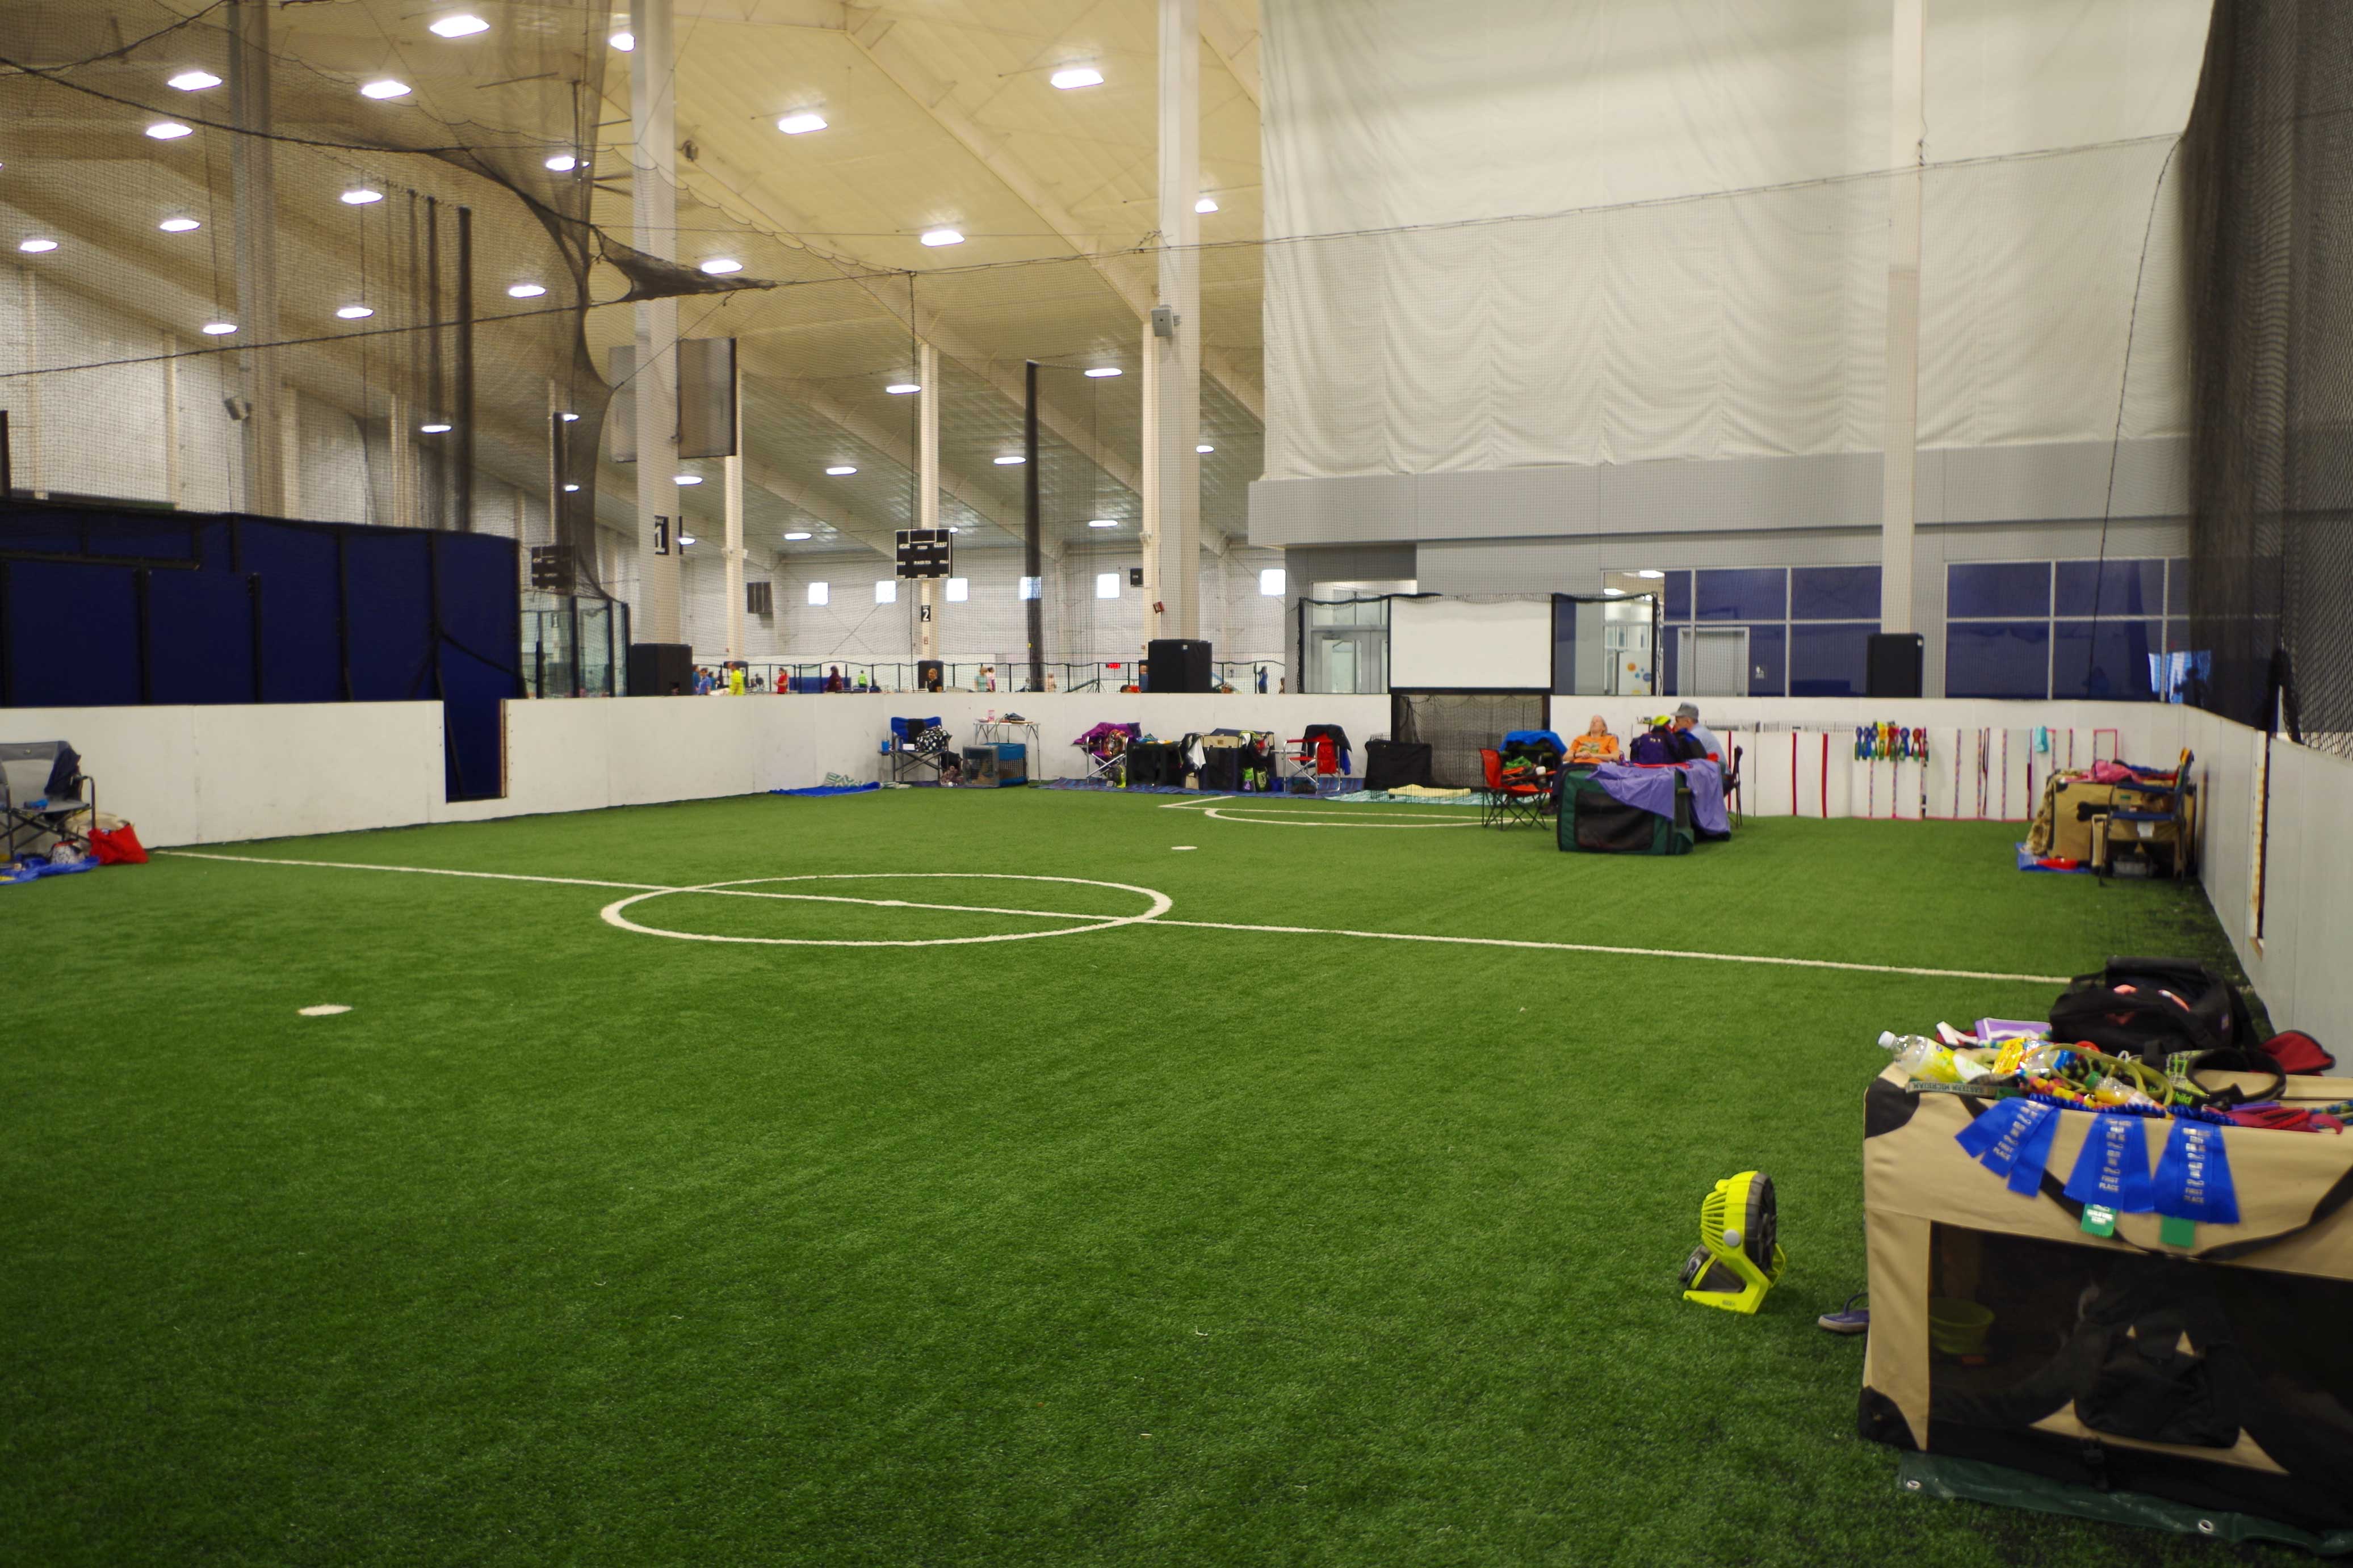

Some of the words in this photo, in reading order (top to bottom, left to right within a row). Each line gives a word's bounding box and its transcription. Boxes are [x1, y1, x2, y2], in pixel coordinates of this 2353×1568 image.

[654, 525, 665, 553] 1
[922, 609, 929, 621] 2
[2175, 1091, 2192, 1105] hild
[2099, 1182, 2119, 1192] PLACE
